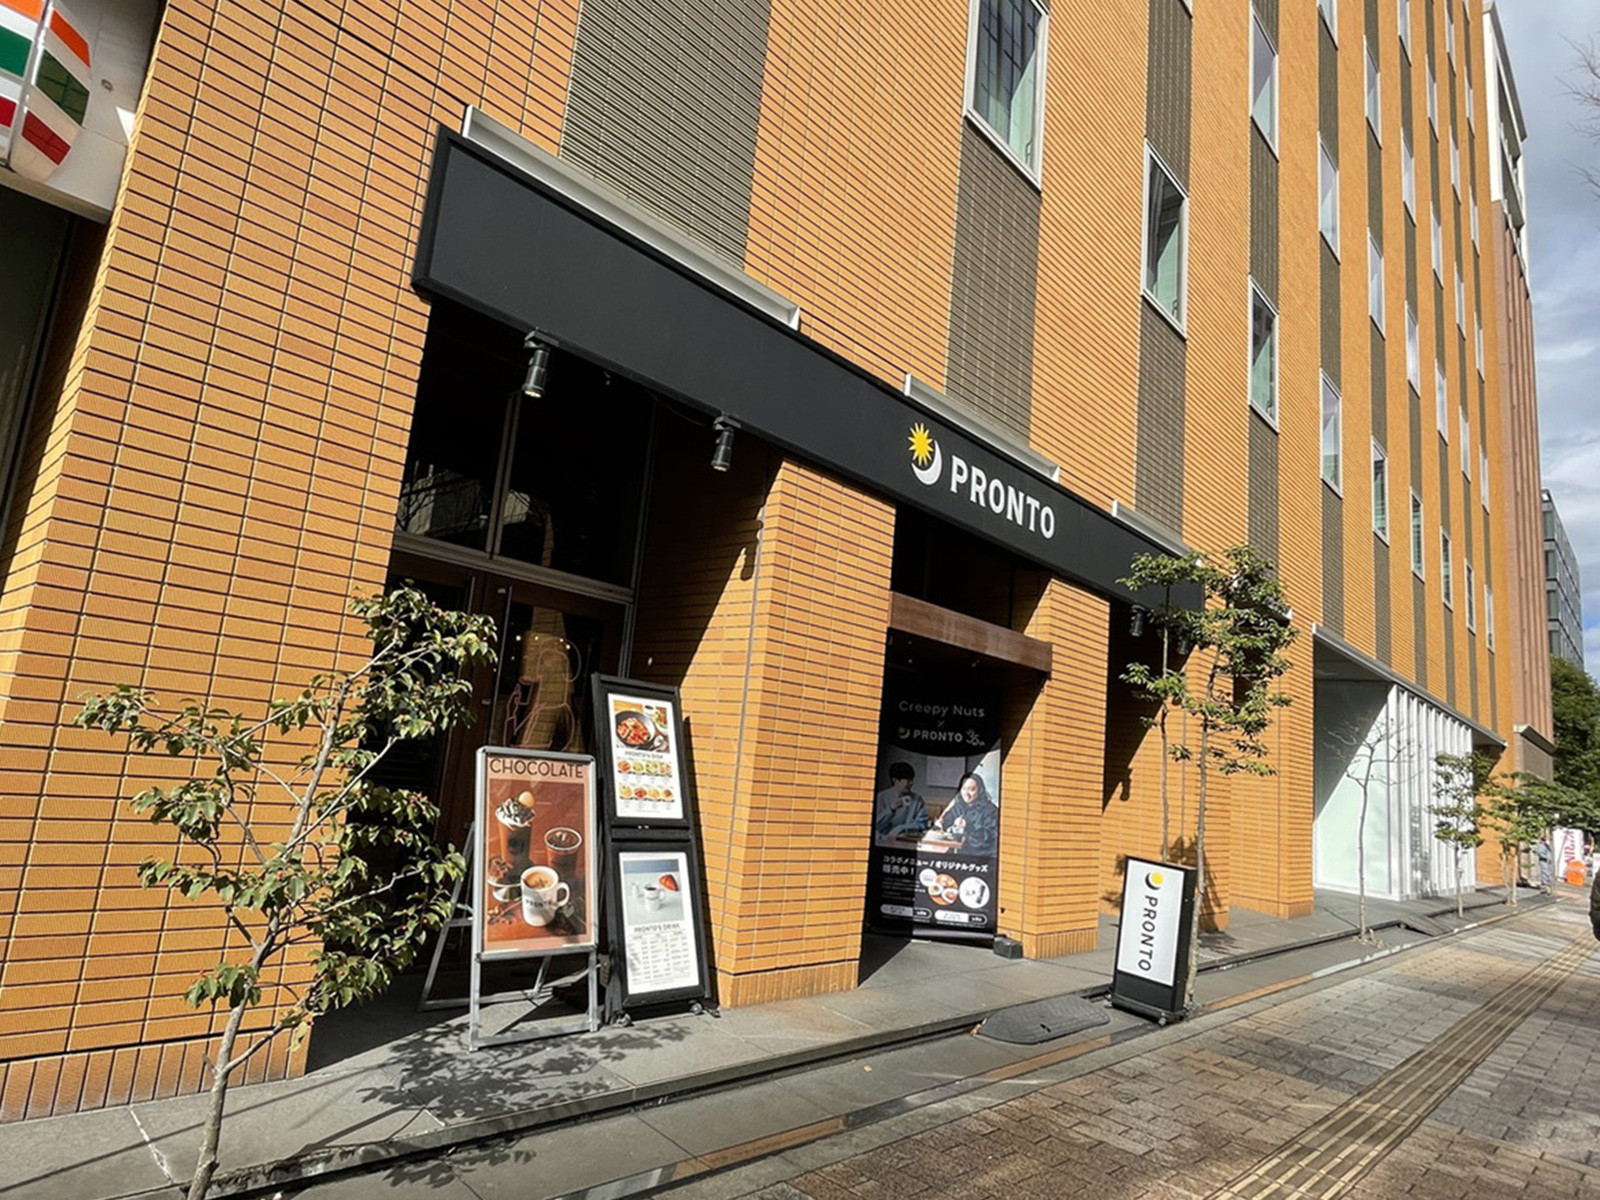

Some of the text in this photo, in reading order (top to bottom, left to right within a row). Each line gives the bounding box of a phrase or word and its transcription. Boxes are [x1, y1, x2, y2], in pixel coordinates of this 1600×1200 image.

[951, 455, 1055, 539] PRONTO
[898, 700, 985, 718] Creepy Nuts
[913, 729, 963, 743] PRONTO
[489, 758, 583, 778] CHOCOLATE
[1138, 895, 1158, 972] PRONTO
